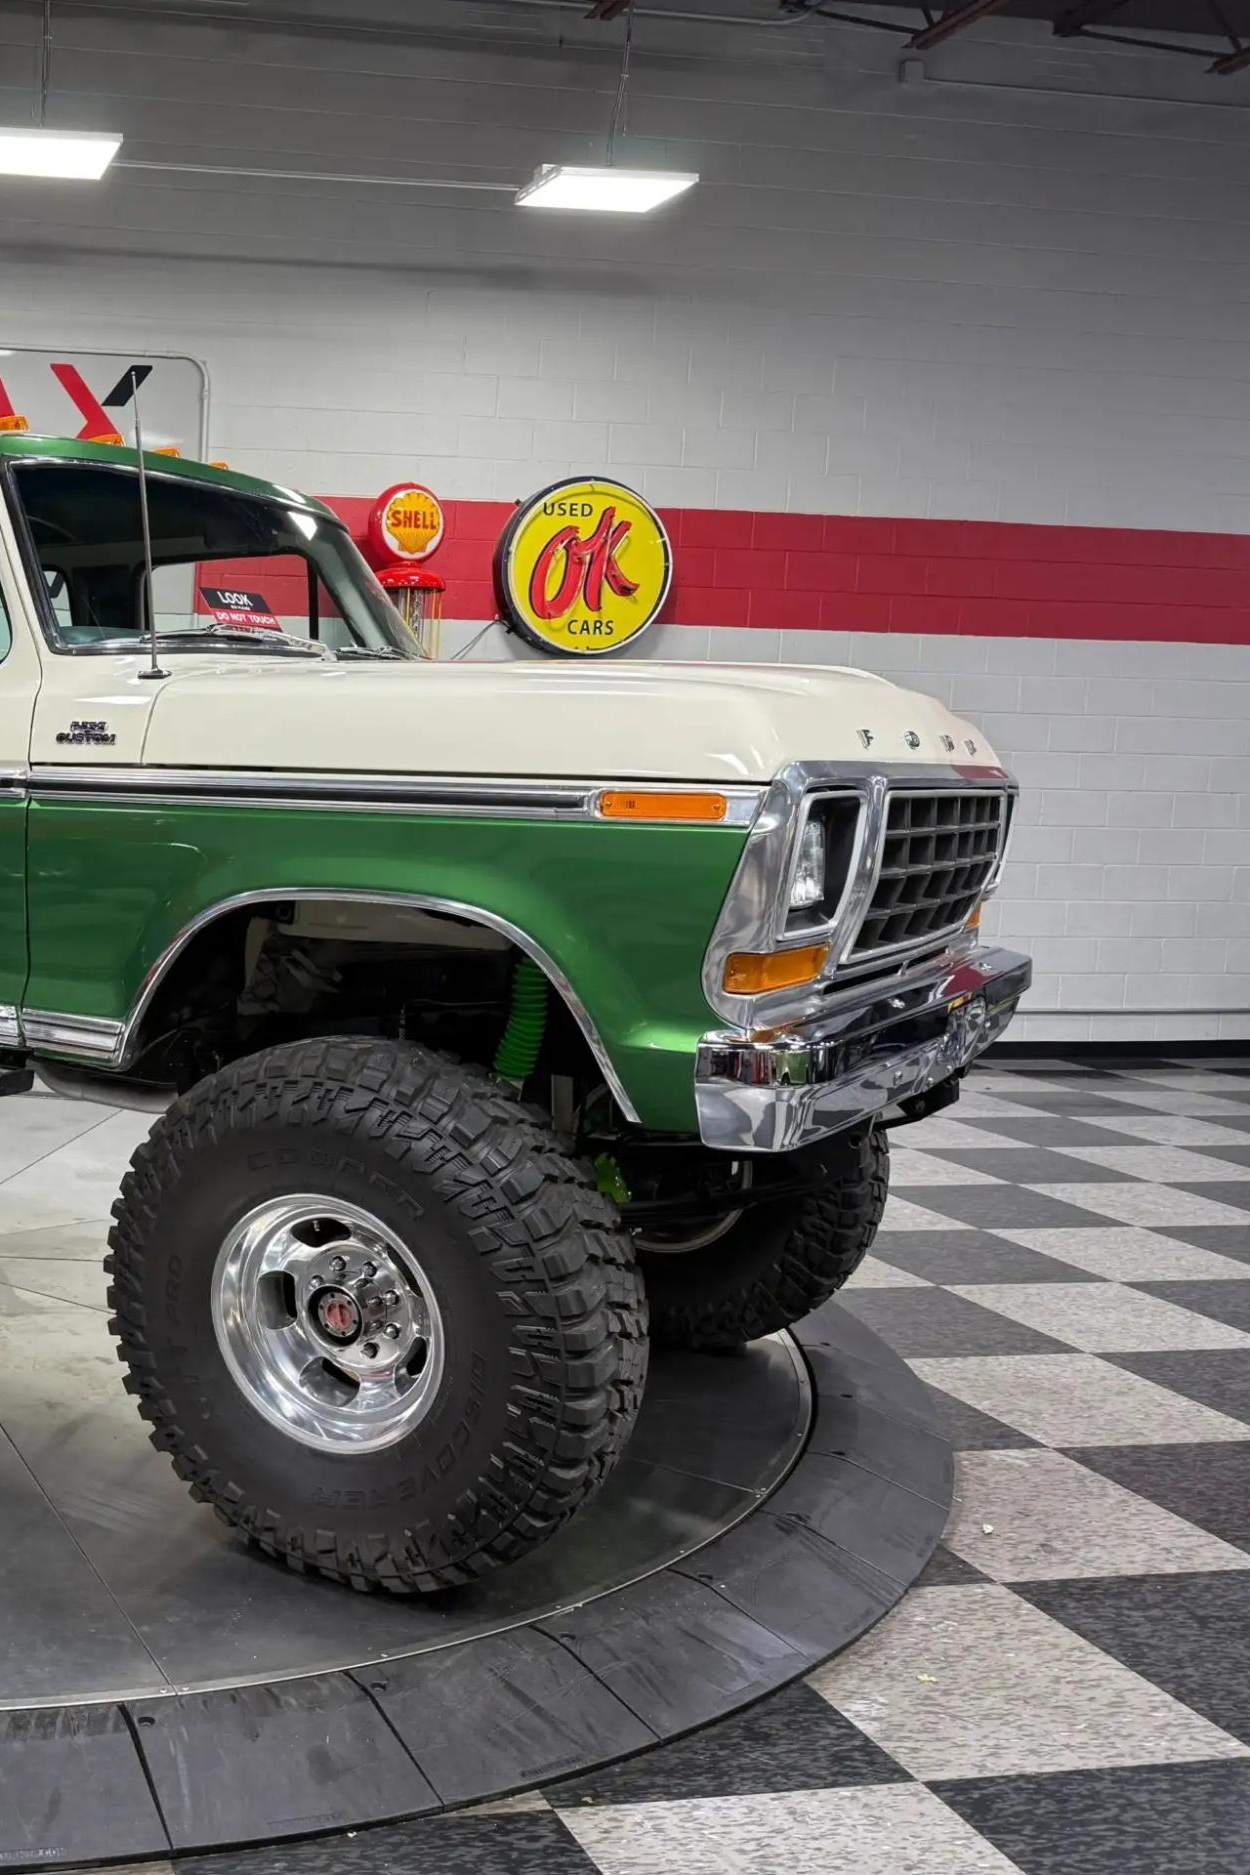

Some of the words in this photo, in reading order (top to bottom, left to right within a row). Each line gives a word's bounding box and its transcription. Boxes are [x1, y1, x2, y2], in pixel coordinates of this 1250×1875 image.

[543, 501, 593, 518] USED
[390, 509, 437, 531] SHELL
[529, 506, 640, 620] OK
[216, 591, 254, 606] LOOK
[216, 611, 230, 621] DO
[230, 613, 247, 622] NOT
[247, 614, 276, 625] TOUCH
[568, 619, 614, 636] CARS
